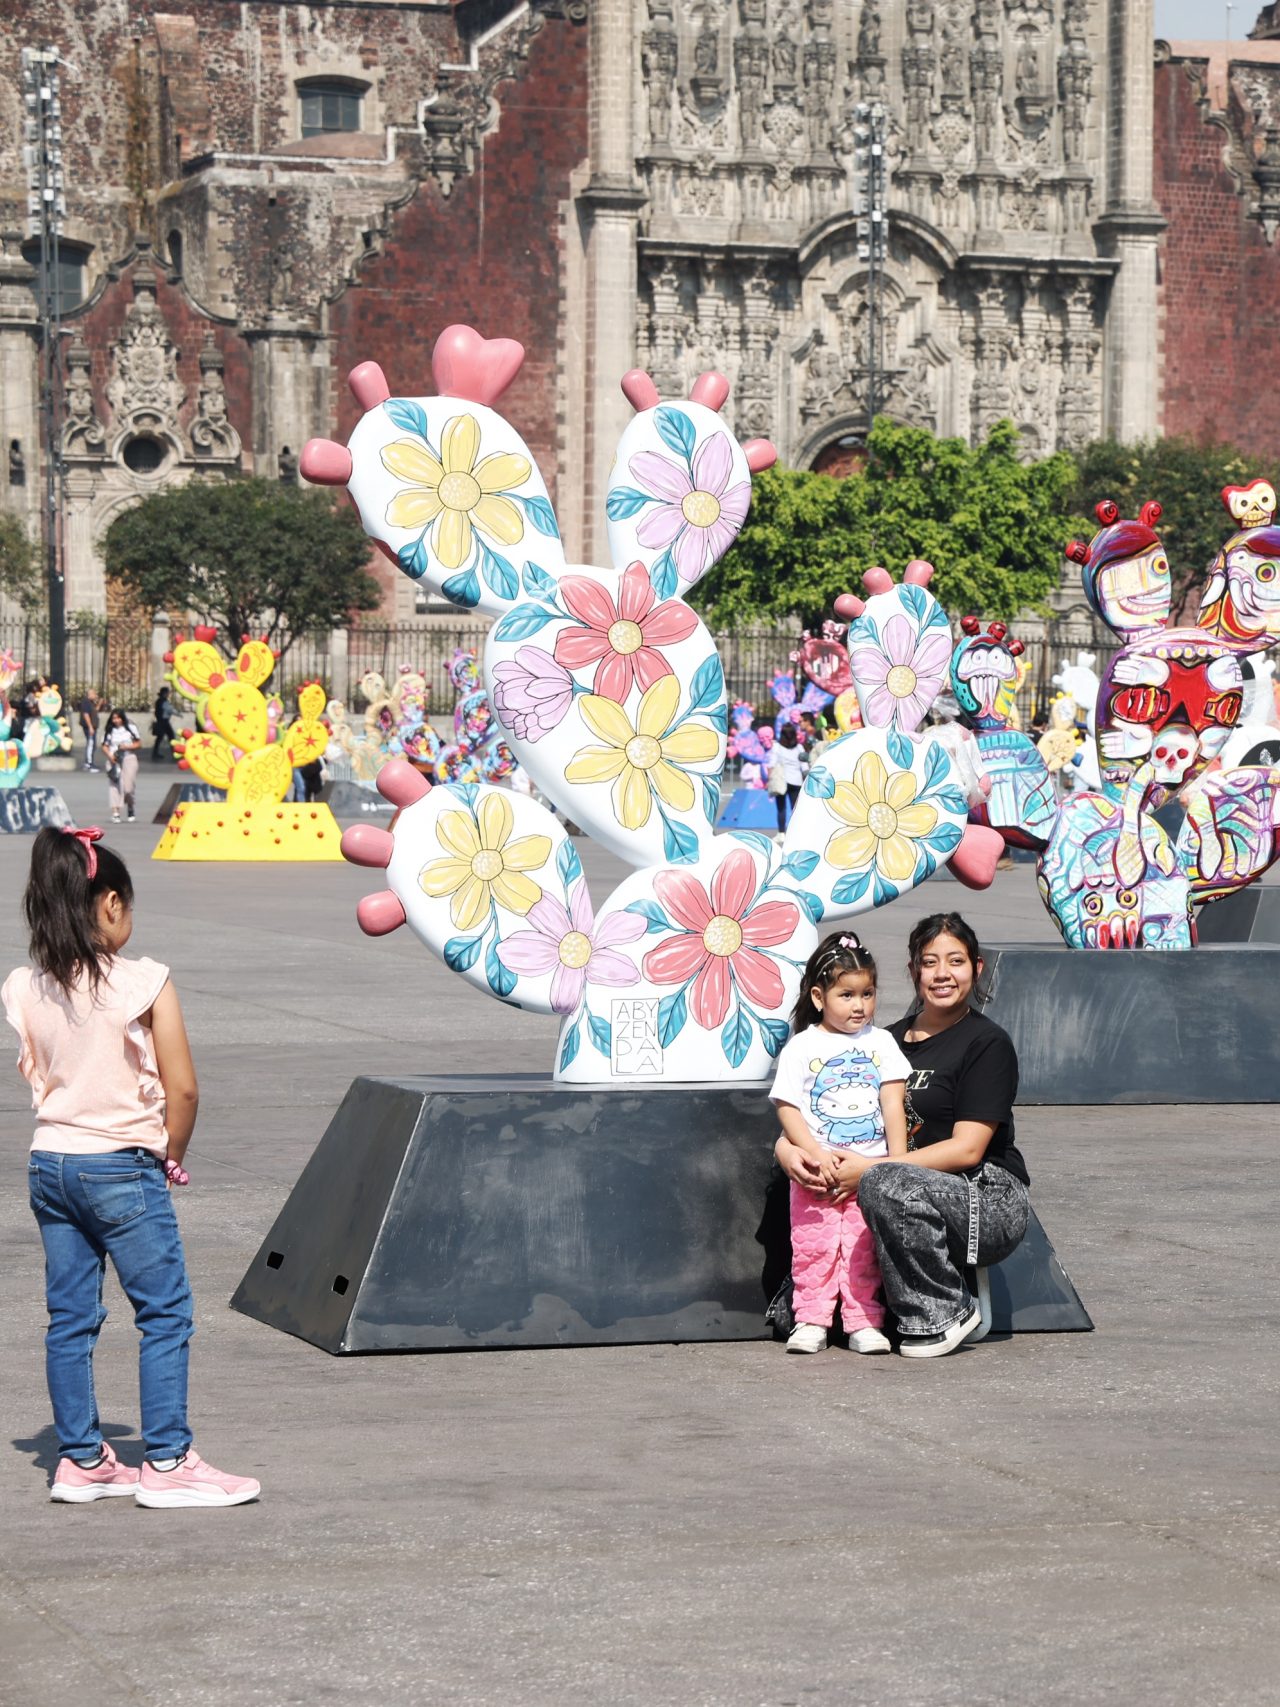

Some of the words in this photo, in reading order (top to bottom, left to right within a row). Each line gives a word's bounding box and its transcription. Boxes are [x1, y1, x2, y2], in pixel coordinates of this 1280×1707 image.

[616, 1020, 657, 1039] ZEN
[615, 1038, 659, 1056] DA
[615, 1055, 658, 1074] LA
